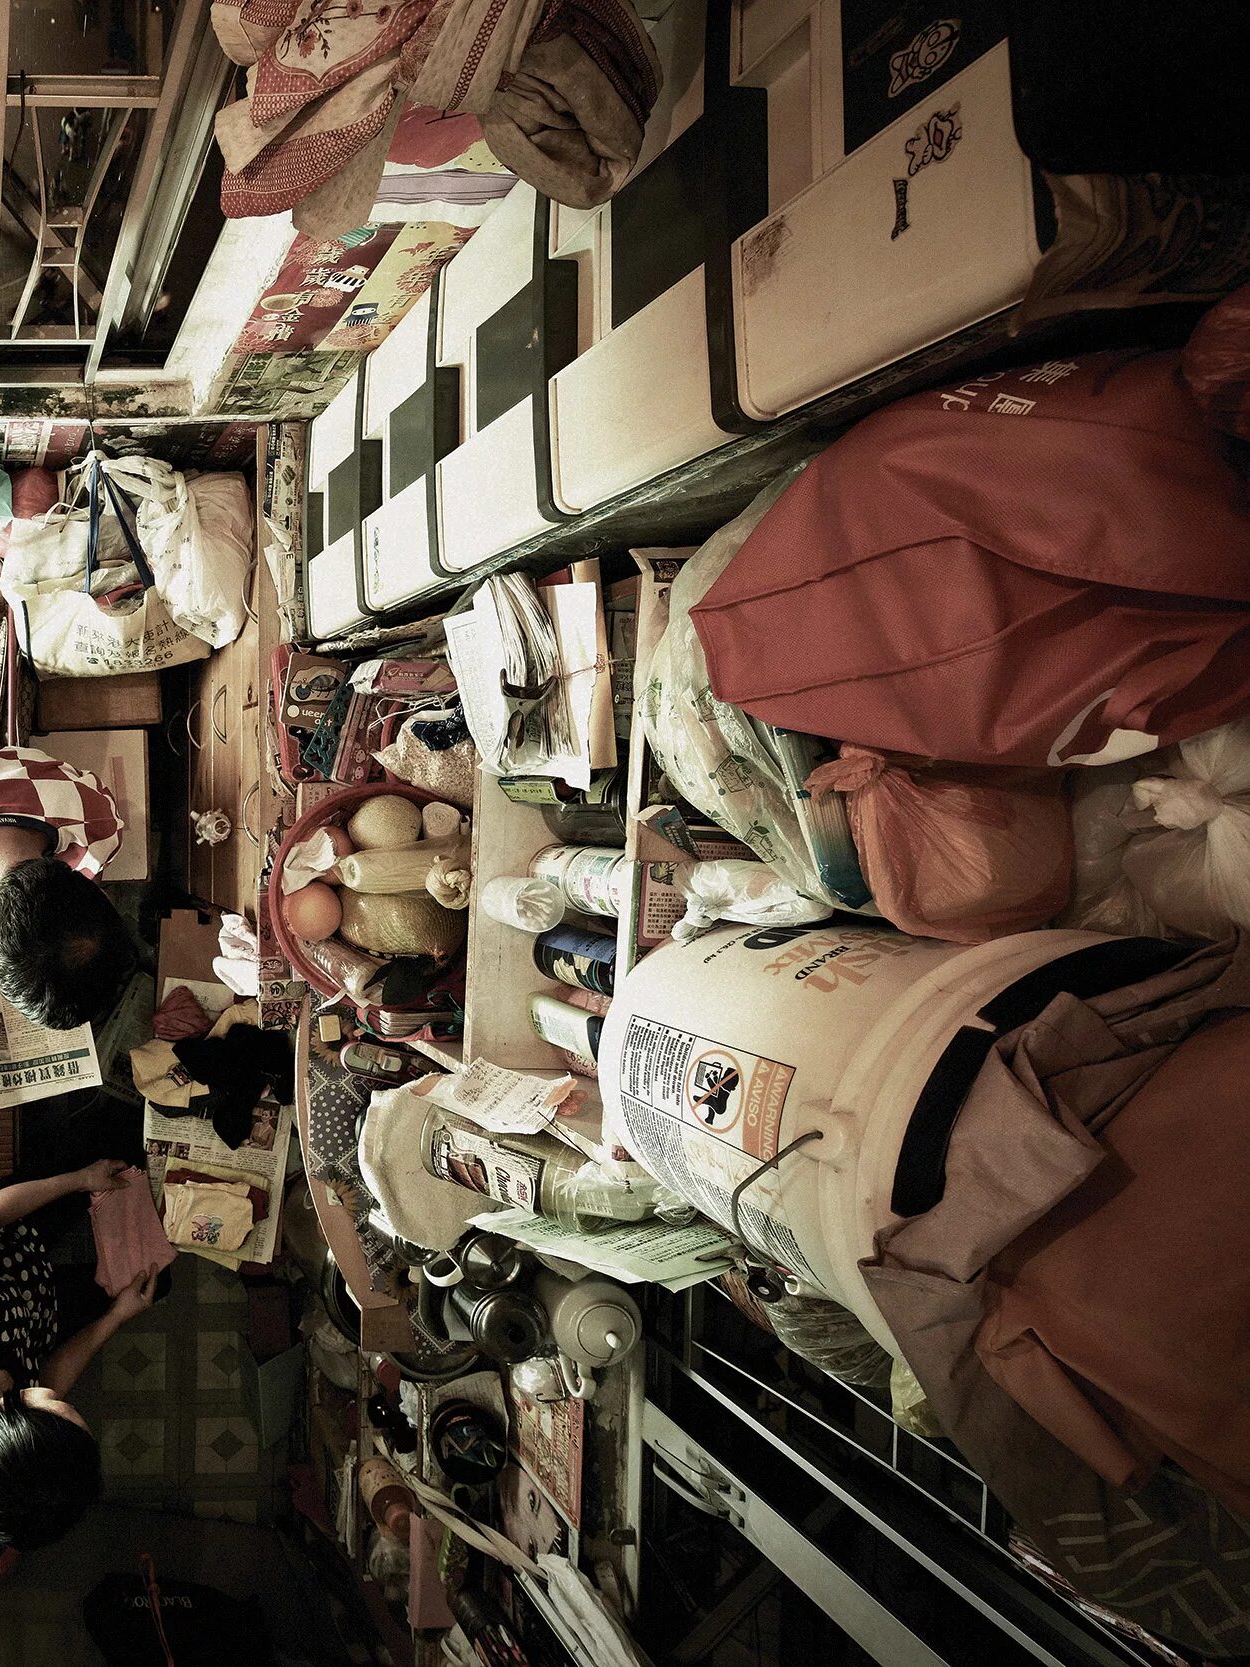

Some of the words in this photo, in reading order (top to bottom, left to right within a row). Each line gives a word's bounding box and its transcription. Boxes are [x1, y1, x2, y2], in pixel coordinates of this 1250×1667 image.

[795, 945, 851, 981] BRAND
[680, 1044, 690, 1068] Children
[747, 1078, 764, 1127] AVISO
[762, 1076, 788, 1162] WARNING
